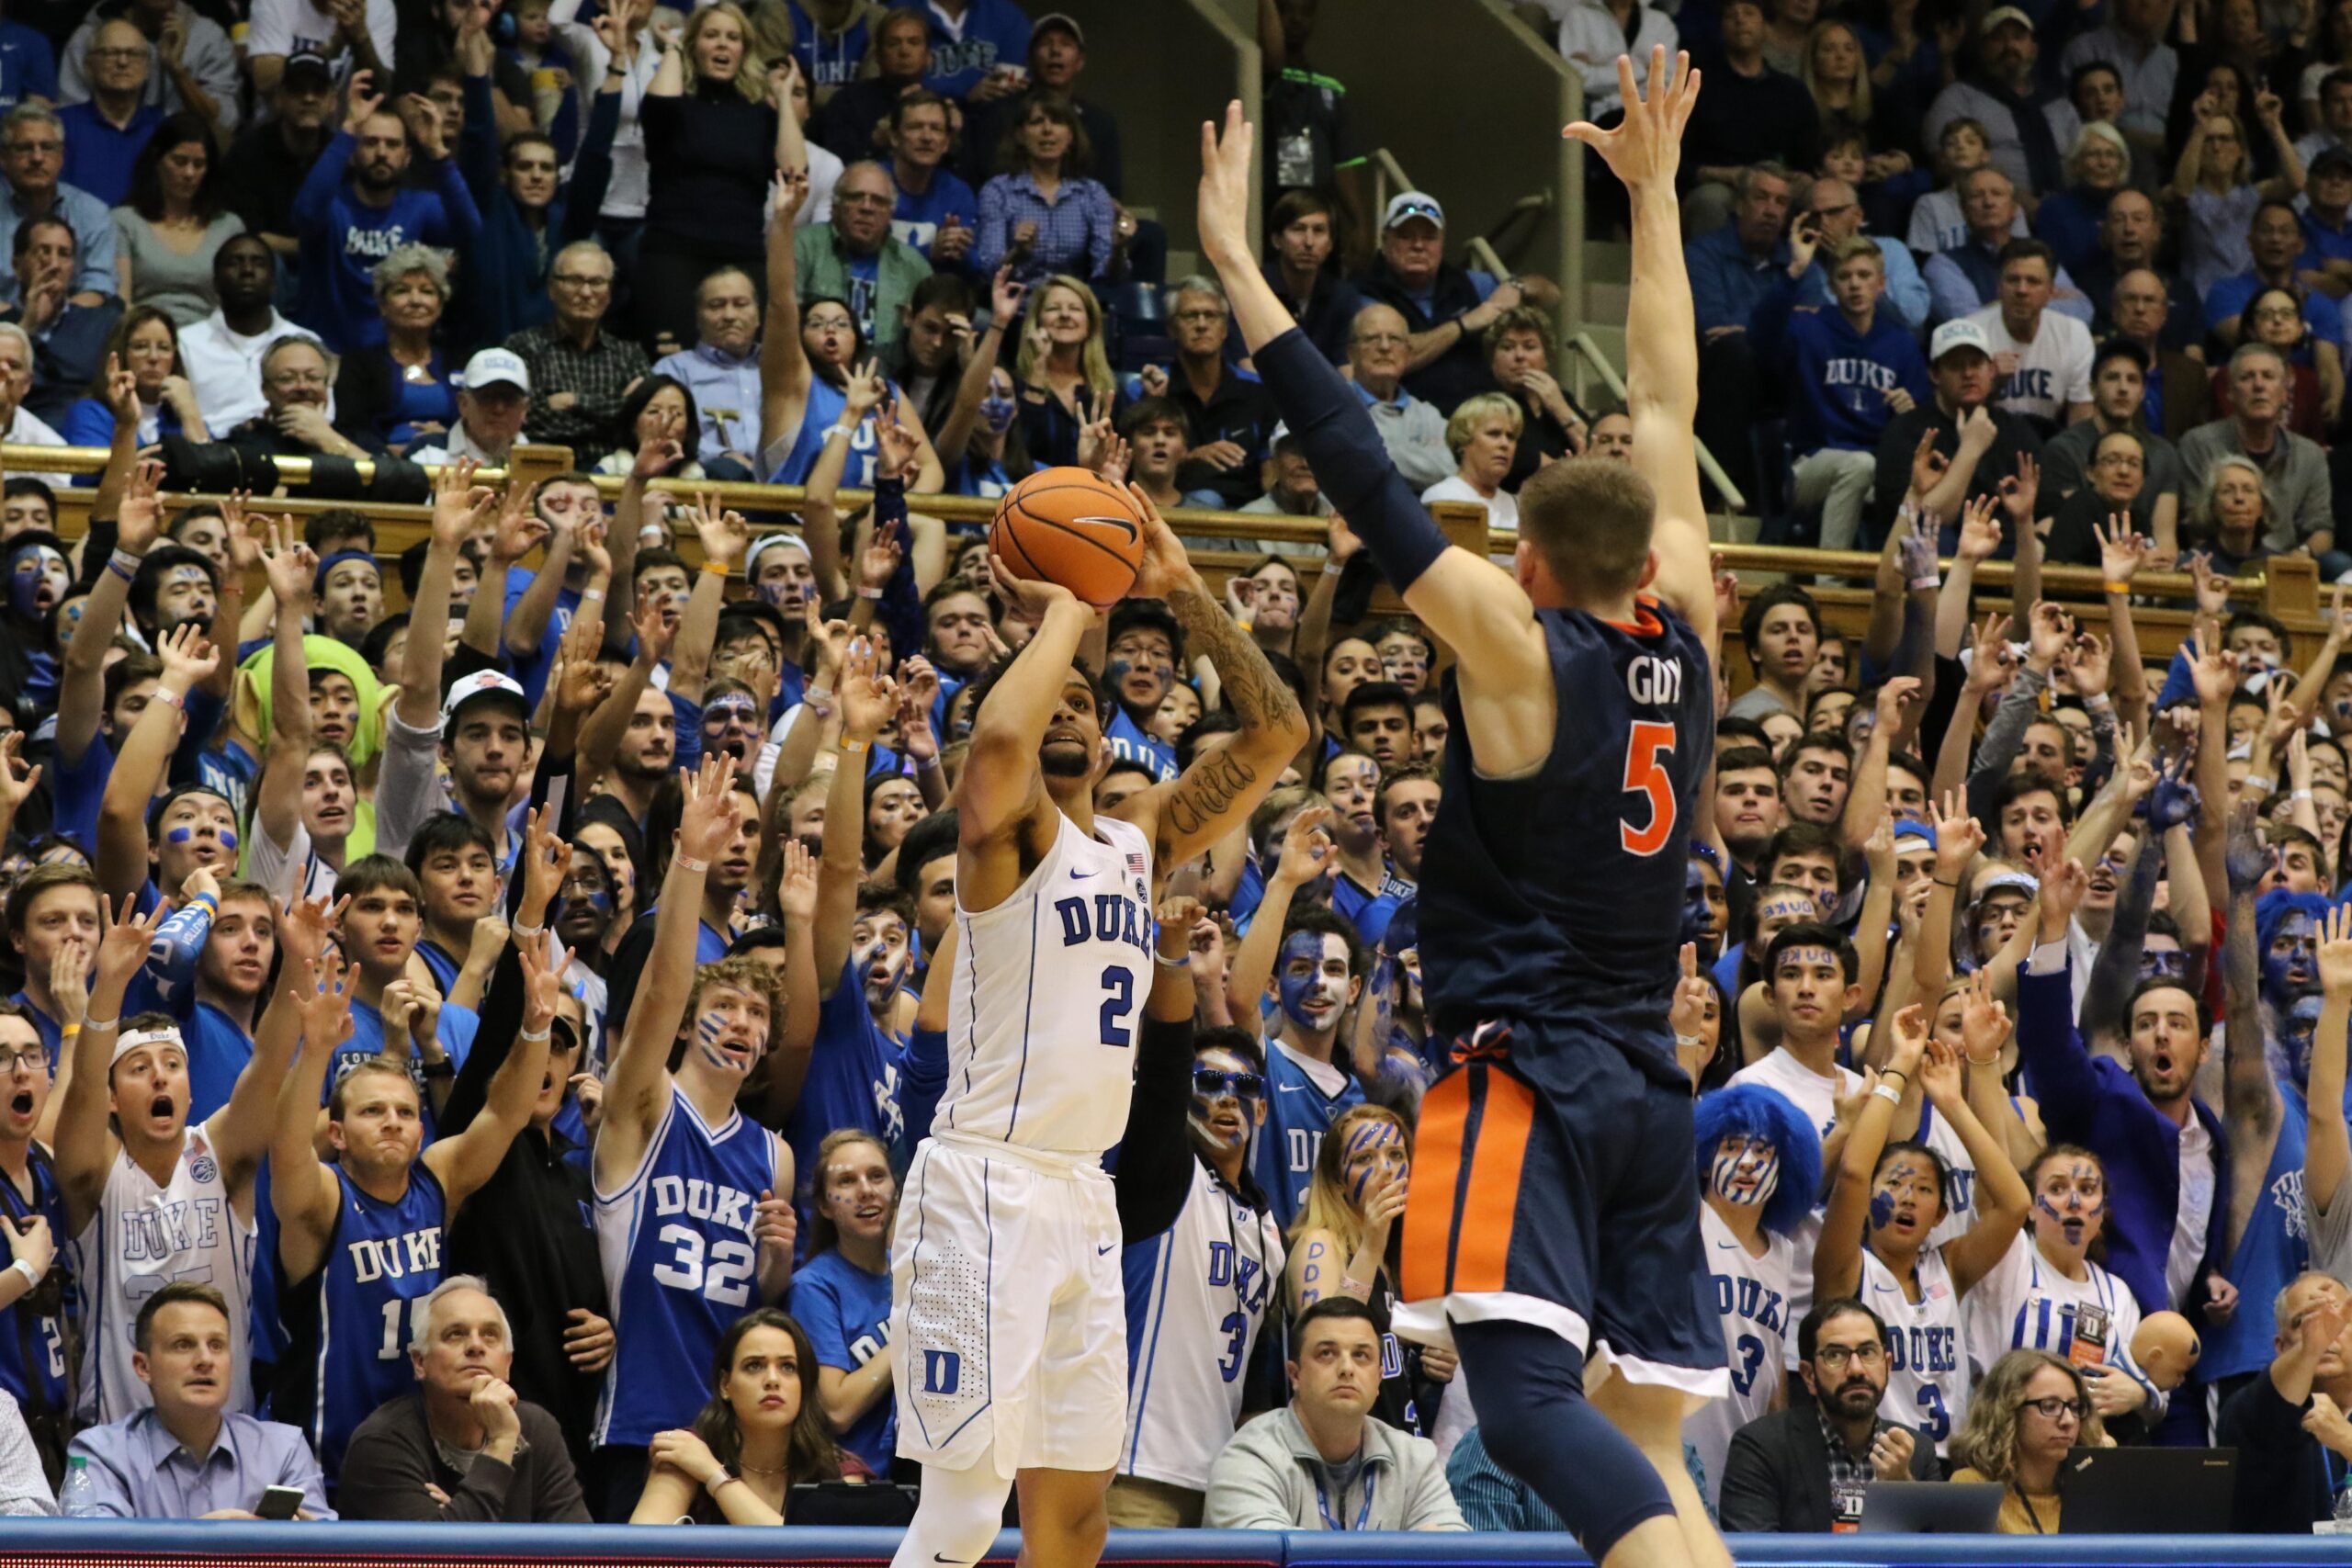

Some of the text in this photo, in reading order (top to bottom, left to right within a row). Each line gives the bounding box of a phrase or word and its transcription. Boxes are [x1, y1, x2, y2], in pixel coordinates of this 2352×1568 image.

[1825, 358, 1896, 392] DUKE
[1627, 655, 1681, 705] GUY
[1112, 736, 1178, 784] DUK
[1618, 719, 1677, 855] 5
[1055, 892, 1154, 961] DUKE
[1099, 964, 1134, 1047] 2
[122, 1197, 220, 1260] DUKE
[650, 1176, 759, 1236] DUK
[348, 1226, 442, 1284] DUKE
[651, 1223, 755, 1308] 32
[1208, 1241, 1269, 1315] DKE
[1715, 1273, 1790, 1340] DUK
[922, 1348, 961, 1395] D
[1218, 1311, 1249, 1382] 3
[1736, 1333, 1766, 1396] 3
[1886, 1325, 1956, 1371] DUKE
[1917, 1382, 1951, 1441] 3
